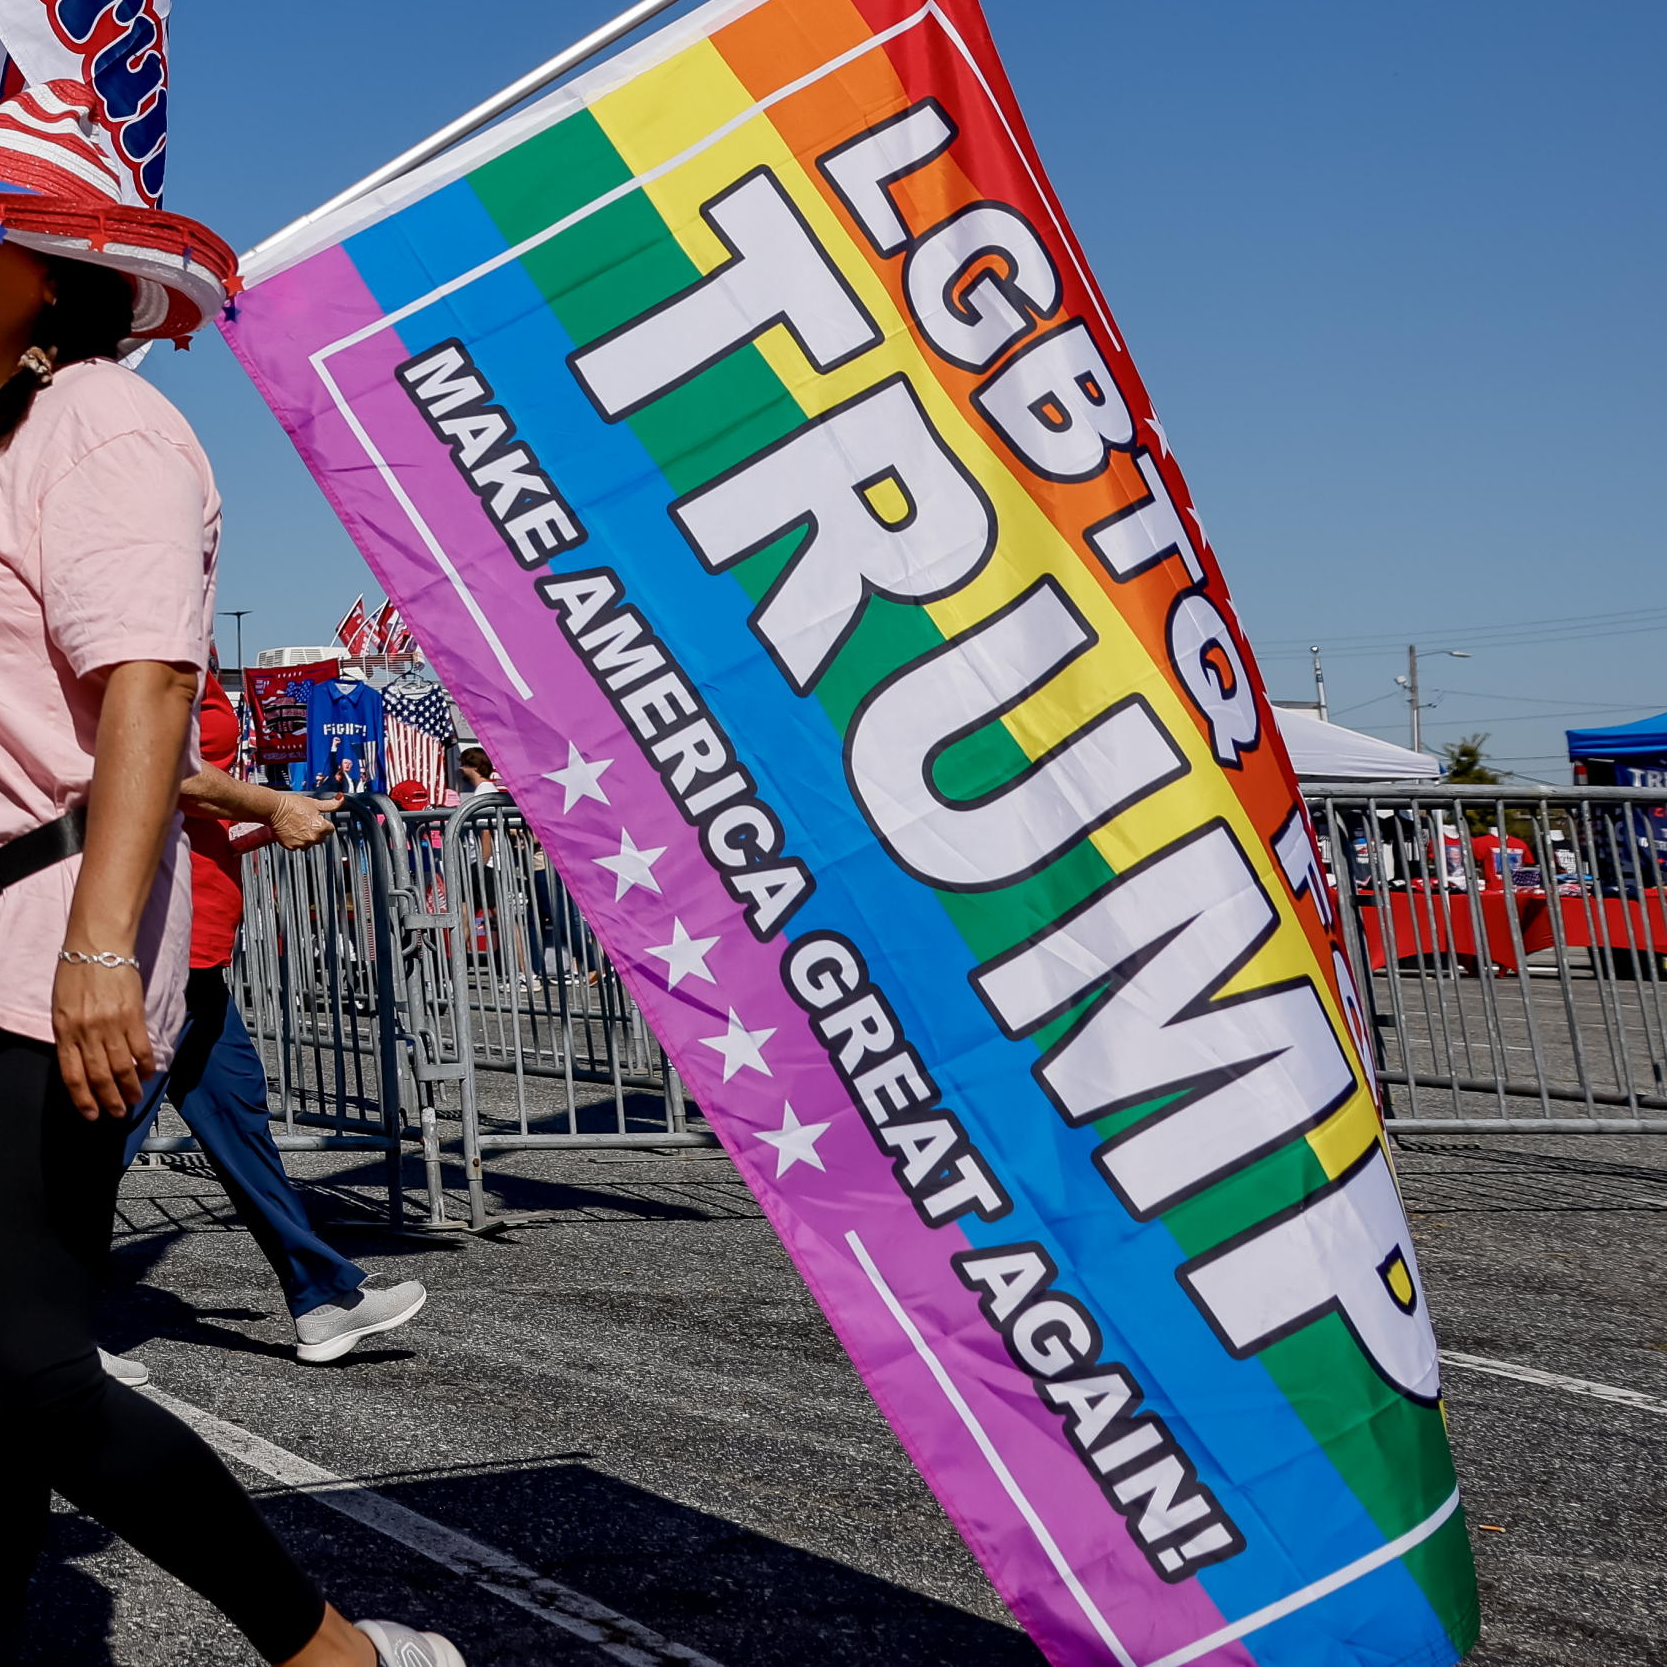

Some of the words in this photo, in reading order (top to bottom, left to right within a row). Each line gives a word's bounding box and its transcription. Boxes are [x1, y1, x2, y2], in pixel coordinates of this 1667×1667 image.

[396, 336, 586, 571] MAKE
[535, 564, 809, 945] AMERICA
[779, 928, 1011, 1229] GREAT
[952, 1241, 1246, 1585] AGAIN!
[569, 163, 1443, 1411] TRUMP
